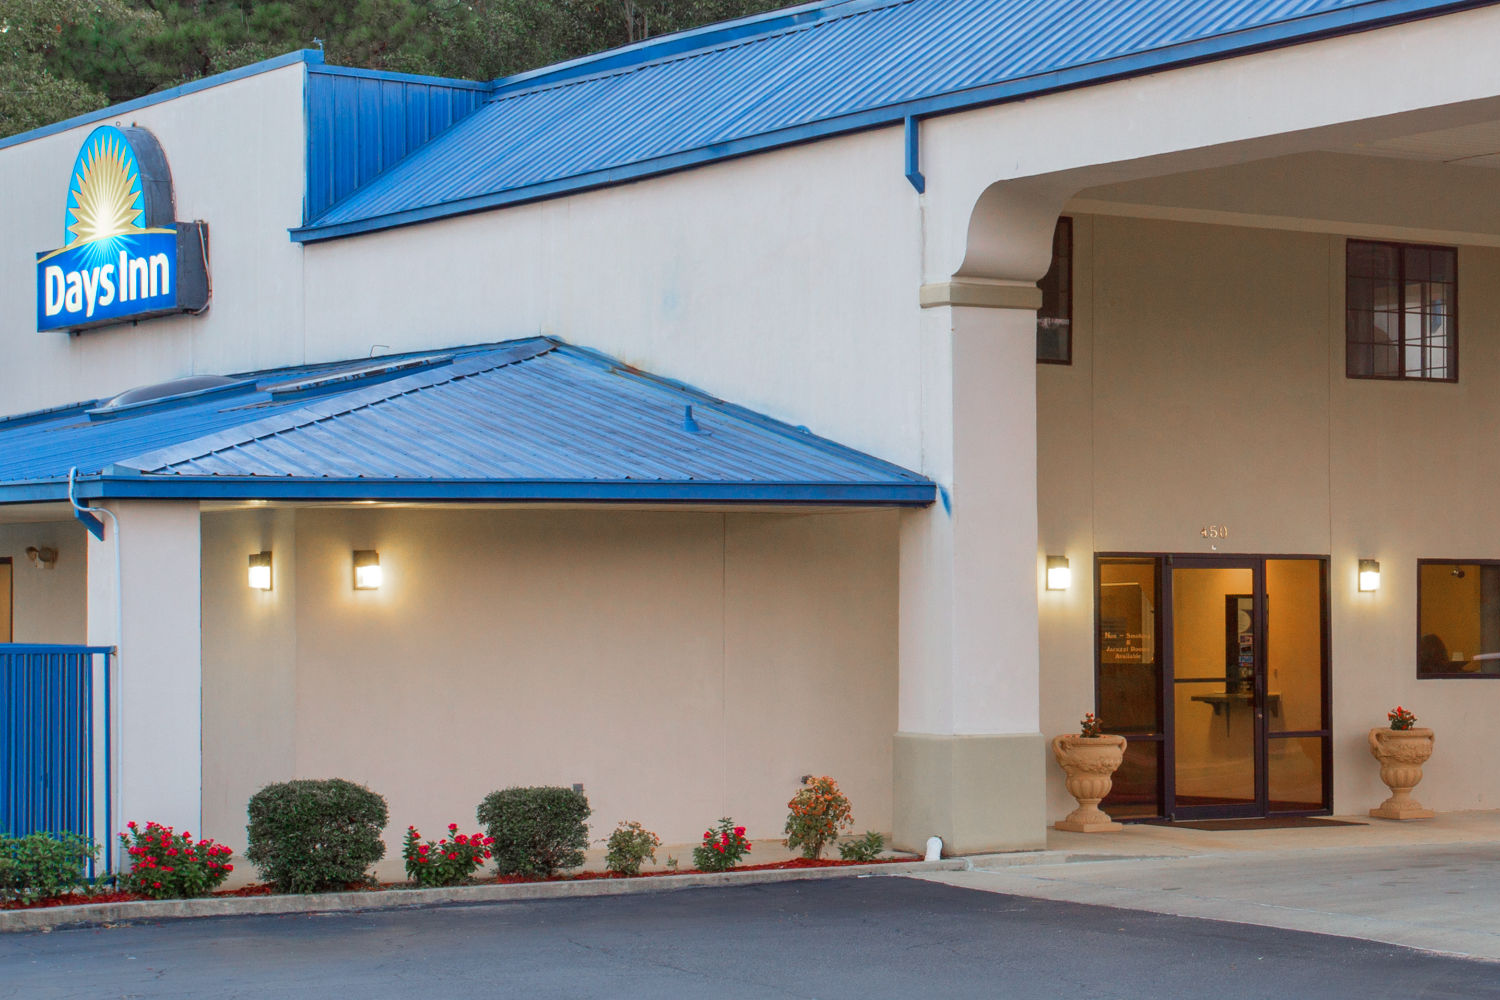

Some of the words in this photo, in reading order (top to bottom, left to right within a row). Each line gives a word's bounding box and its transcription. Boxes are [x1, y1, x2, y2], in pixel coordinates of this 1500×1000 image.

[45, 264, 115, 317] Days
[119, 250, 169, 302] Inn
[1200, 525, 1228, 539] 450
